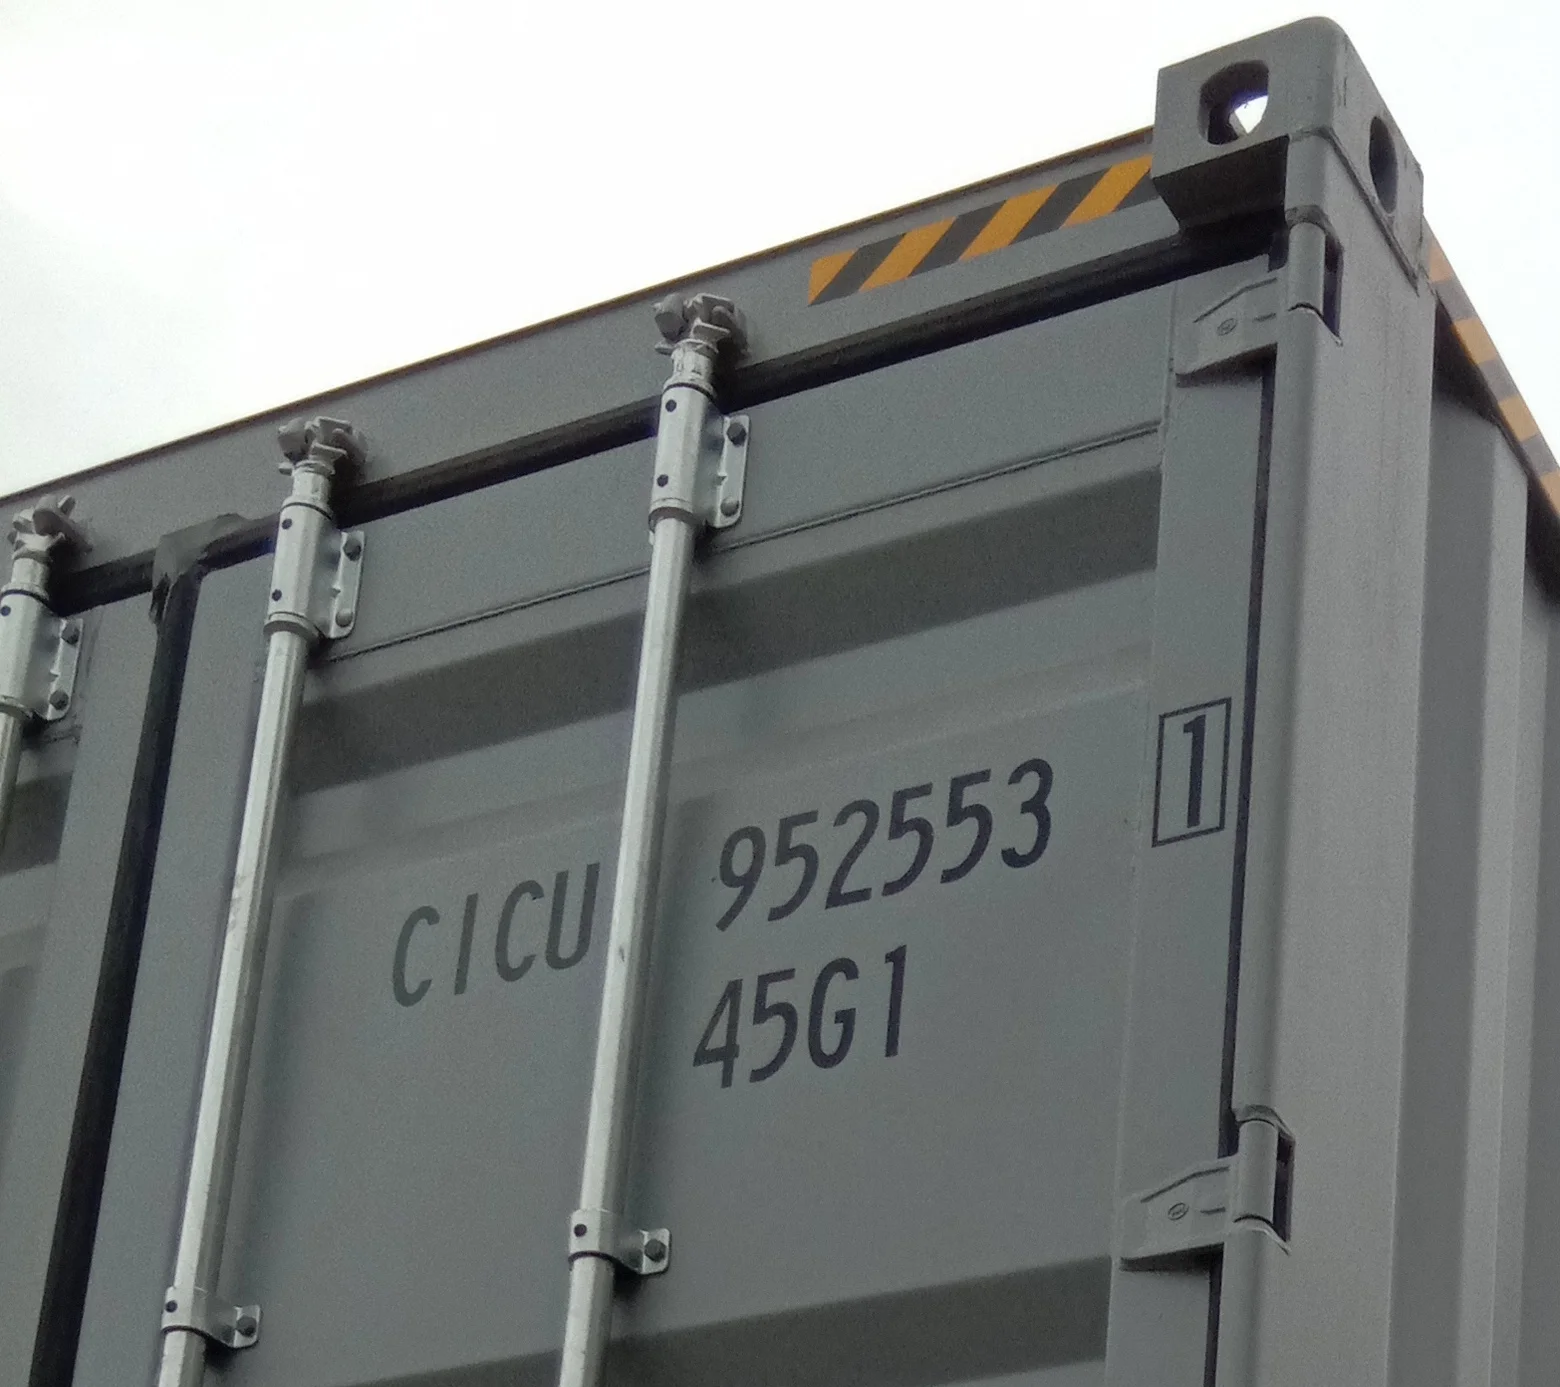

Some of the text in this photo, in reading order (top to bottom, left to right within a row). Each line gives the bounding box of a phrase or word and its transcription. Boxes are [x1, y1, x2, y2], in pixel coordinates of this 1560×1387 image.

[391, 714, 1207, 1008] CICU 952553 1
[692, 944, 909, 1089] 45G1
